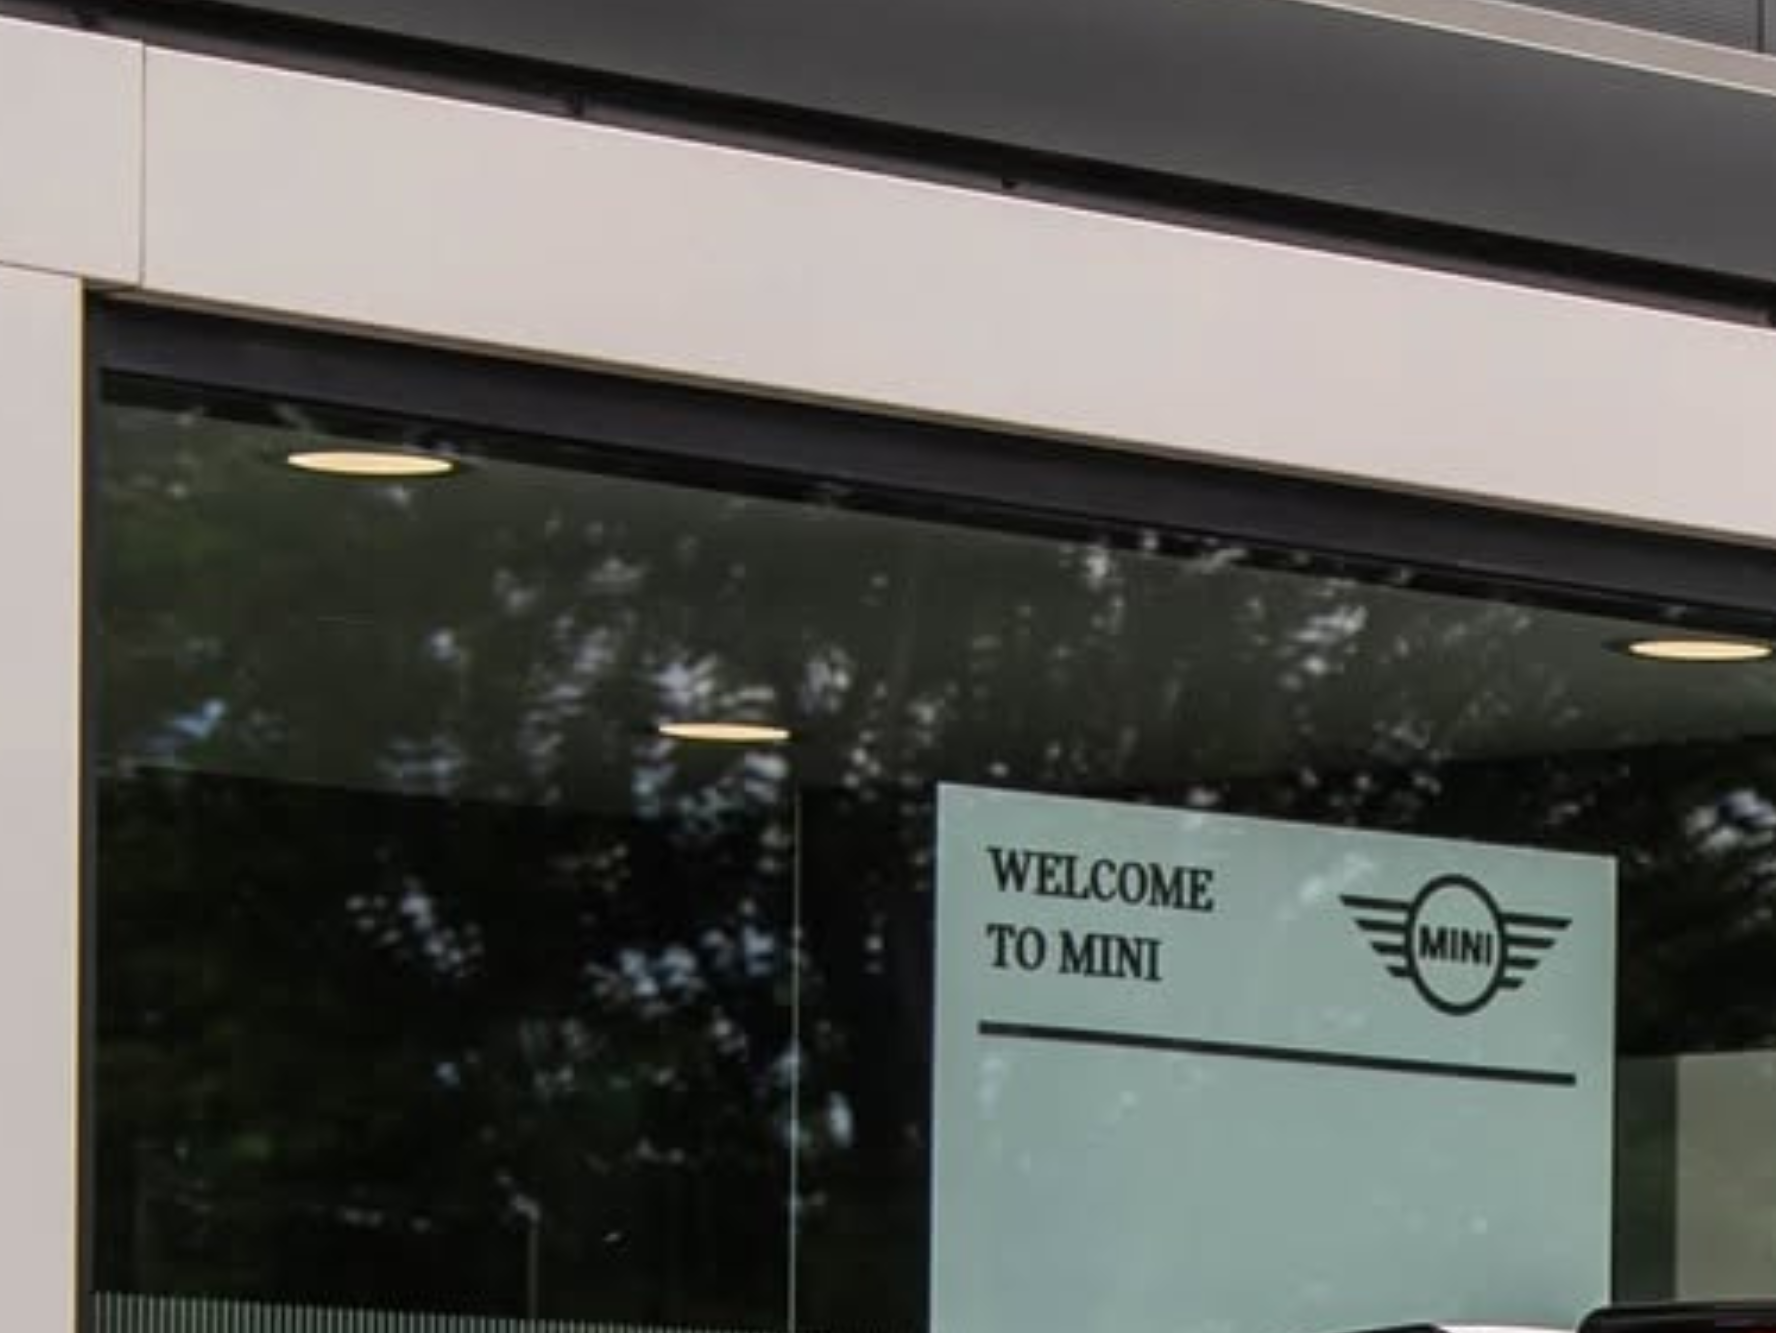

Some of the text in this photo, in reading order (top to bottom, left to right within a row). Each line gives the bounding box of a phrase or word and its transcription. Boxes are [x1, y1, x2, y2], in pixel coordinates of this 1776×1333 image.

[987, 845, 1214, 913] WELCOME
[986, 922, 1163, 982] TO MINI
[1418, 925, 1492, 967] MINI
